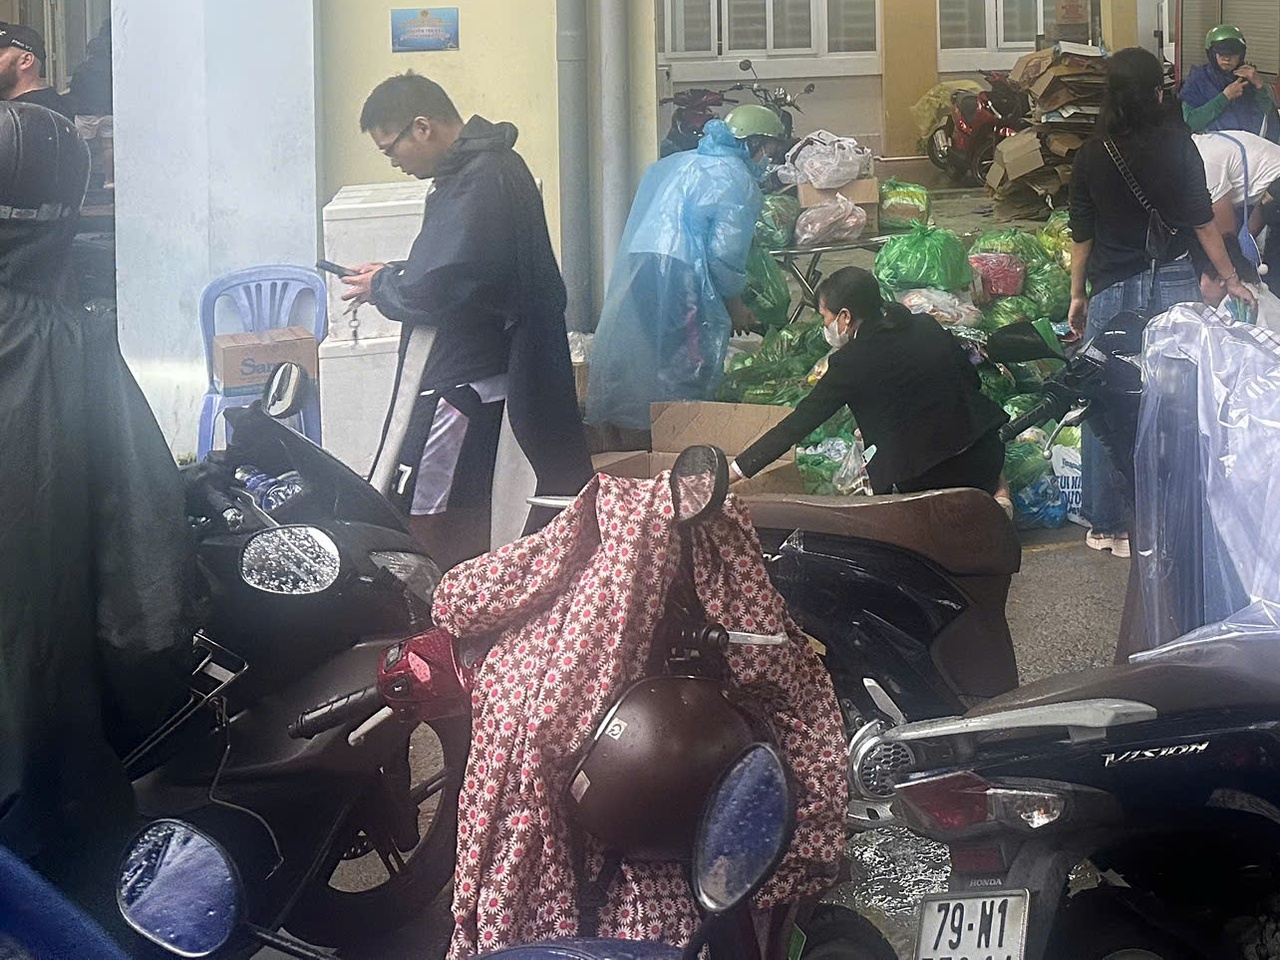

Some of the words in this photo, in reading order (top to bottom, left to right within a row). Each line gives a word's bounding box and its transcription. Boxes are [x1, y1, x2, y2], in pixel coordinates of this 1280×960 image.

[397, 463, 413, 495] 7
[1101, 740, 1210, 767] VISION
[969, 878, 1003, 887] HONDA
[933, 898, 1009, 951] 79-N1
